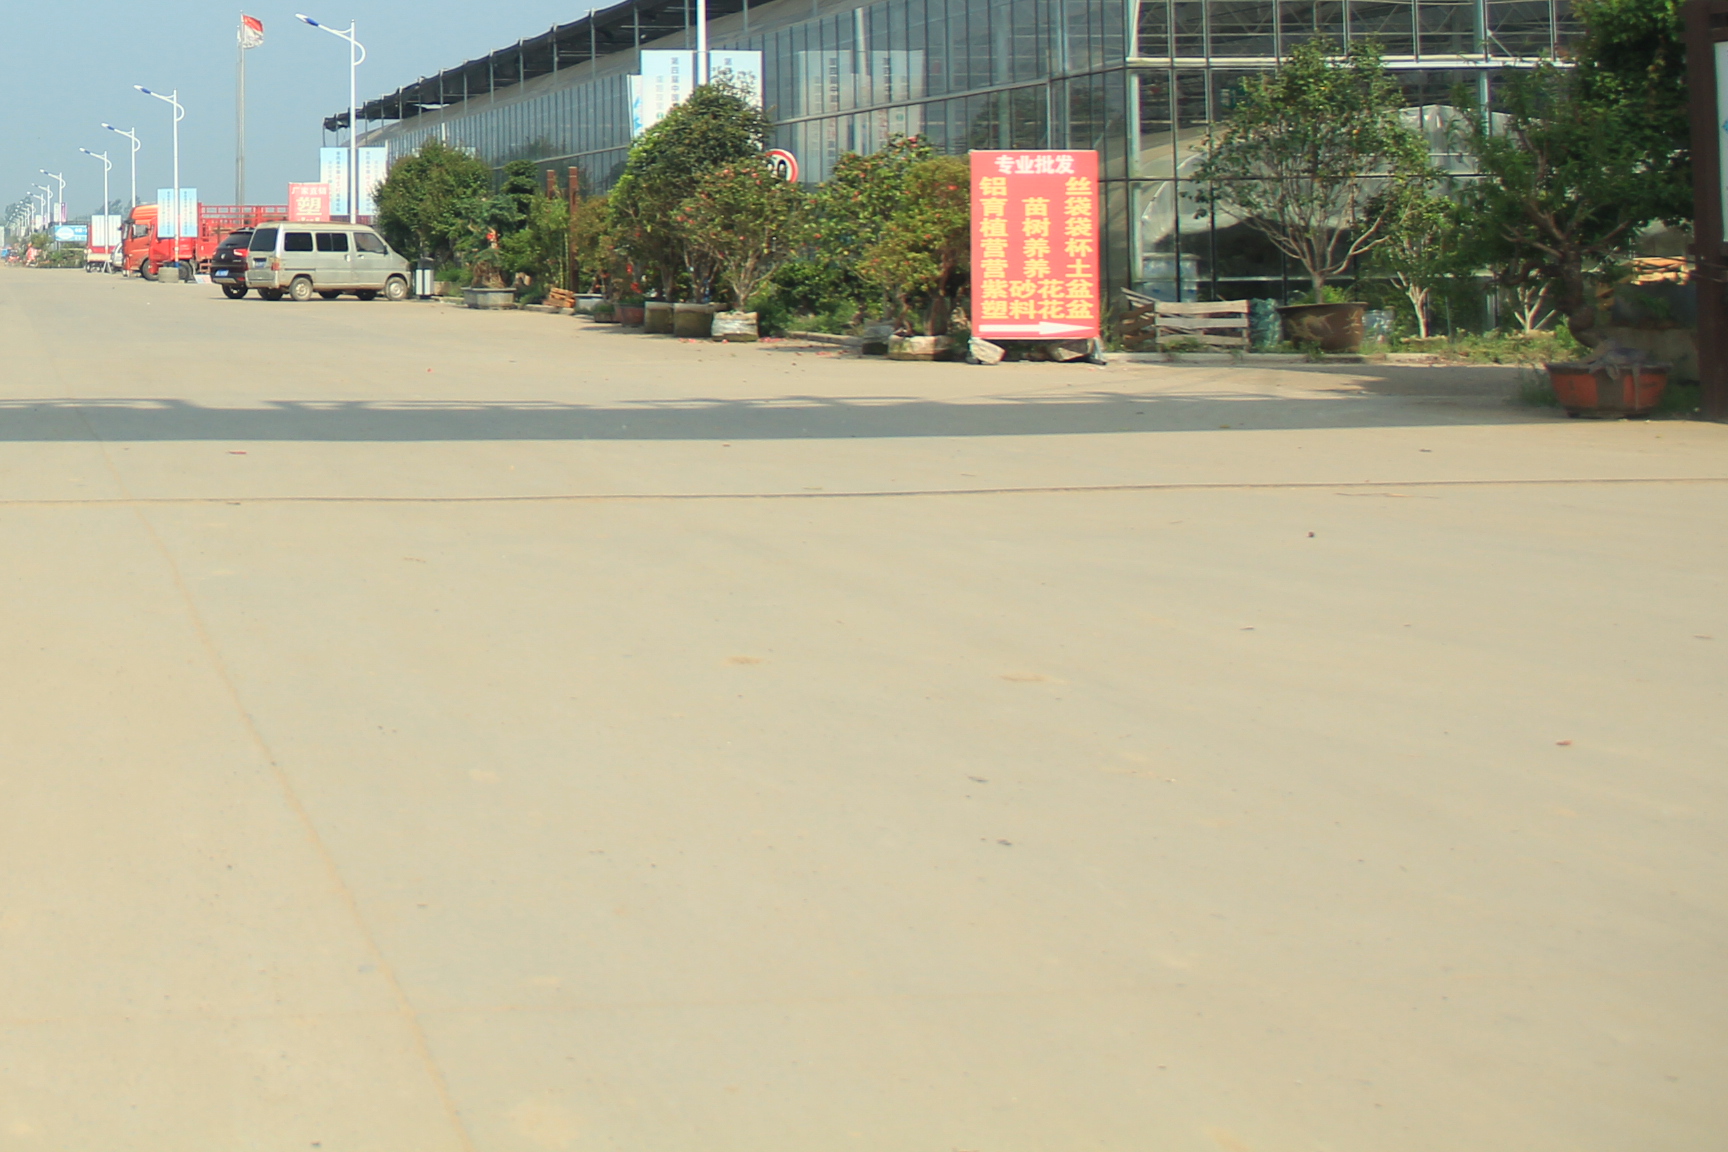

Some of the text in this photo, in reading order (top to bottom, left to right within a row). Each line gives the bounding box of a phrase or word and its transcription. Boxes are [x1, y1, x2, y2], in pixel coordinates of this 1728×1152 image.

[994, 155, 1074, 174] 专业批发
[291, 186, 327, 195] 厂家直销
[979, 177, 1093, 196] 铝丝
[296, 196, 323, 216] 塑
[979, 197, 1093, 217] 育苗袋
[979, 218, 1093, 237] 植树袋
[980, 238, 1093, 258] 营养杯
[980, 259, 1093, 279] 营养土
[980, 279, 1094, 299] 紫砂花盆
[980, 300, 1094, 320] 塑料花盆
